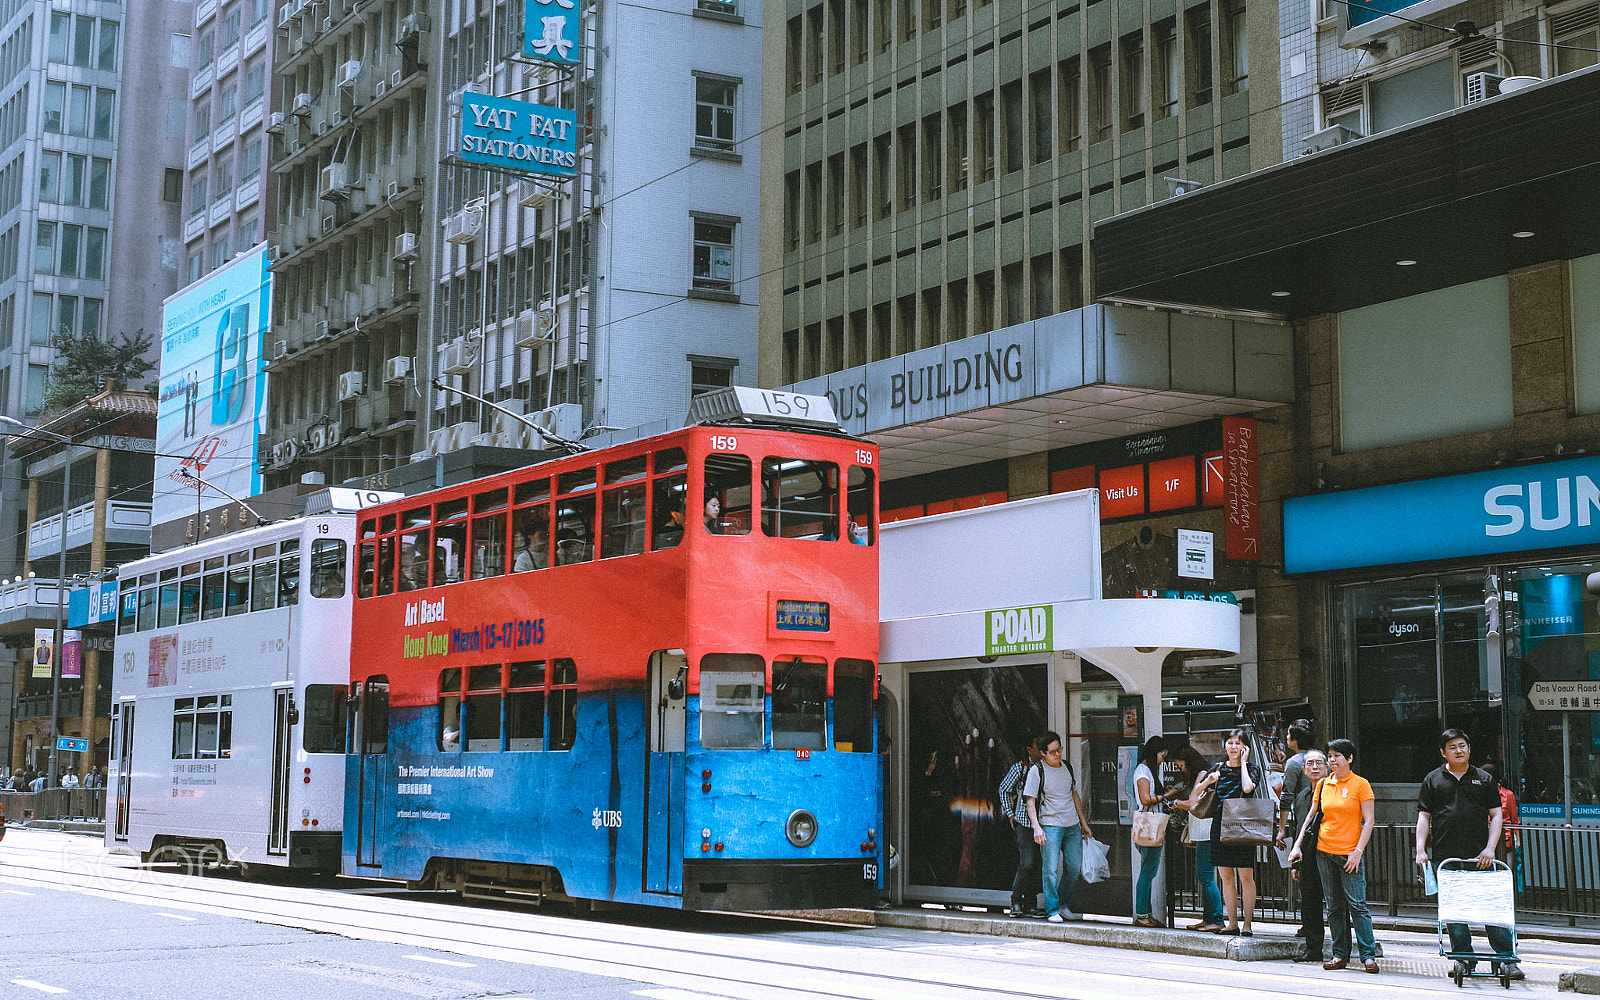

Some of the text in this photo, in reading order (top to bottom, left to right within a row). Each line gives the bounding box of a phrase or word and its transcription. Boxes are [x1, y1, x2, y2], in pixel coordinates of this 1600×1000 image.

[531, 0, 575, 60] 具
[469, 104, 572, 141] YAT FAT
[462, 134, 576, 168] STATIONERS
[210, 288, 227, 308] HEART
[824, 343, 1023, 421] OUS BUILDING
[760, 391, 810, 418] 159
[709, 436, 738, 451] 159
[855, 449, 873, 465] 159
[1164, 478, 1180, 492] 1/F
[1239, 426, 1257, 532] Barkadahan
[354, 491, 381, 508] 19
[1105, 486, 1138, 500] Visit Us
[1483, 475, 1600, 537] SUN
[317, 524, 329, 534] 19
[404, 596, 445, 627] Art Basel
[777, 602, 827, 614] Western Market
[991, 607, 1047, 645] POAD
[1388, 621, 1420, 637] dyson
[1519, 615, 1573, 626] ENNHEISER
[403, 634, 425, 659] Hong
[426, 631, 449, 656] Kong
[452, 626, 480, 653] March
[517, 618, 545, 647] 2015
[991, 642, 1047, 654] SMARTER OUTDOOR
[123, 651, 135, 674] 150
[1535, 684, 1597, 693] Des Voeux Road
[398, 765, 495, 779] The Premier International Art Show
[1521, 806, 1549, 814] SUNING
[1572, 807, 1600, 816] SUNING
[602, 810, 622, 828] UBS
[863, 863, 878, 881] 159
